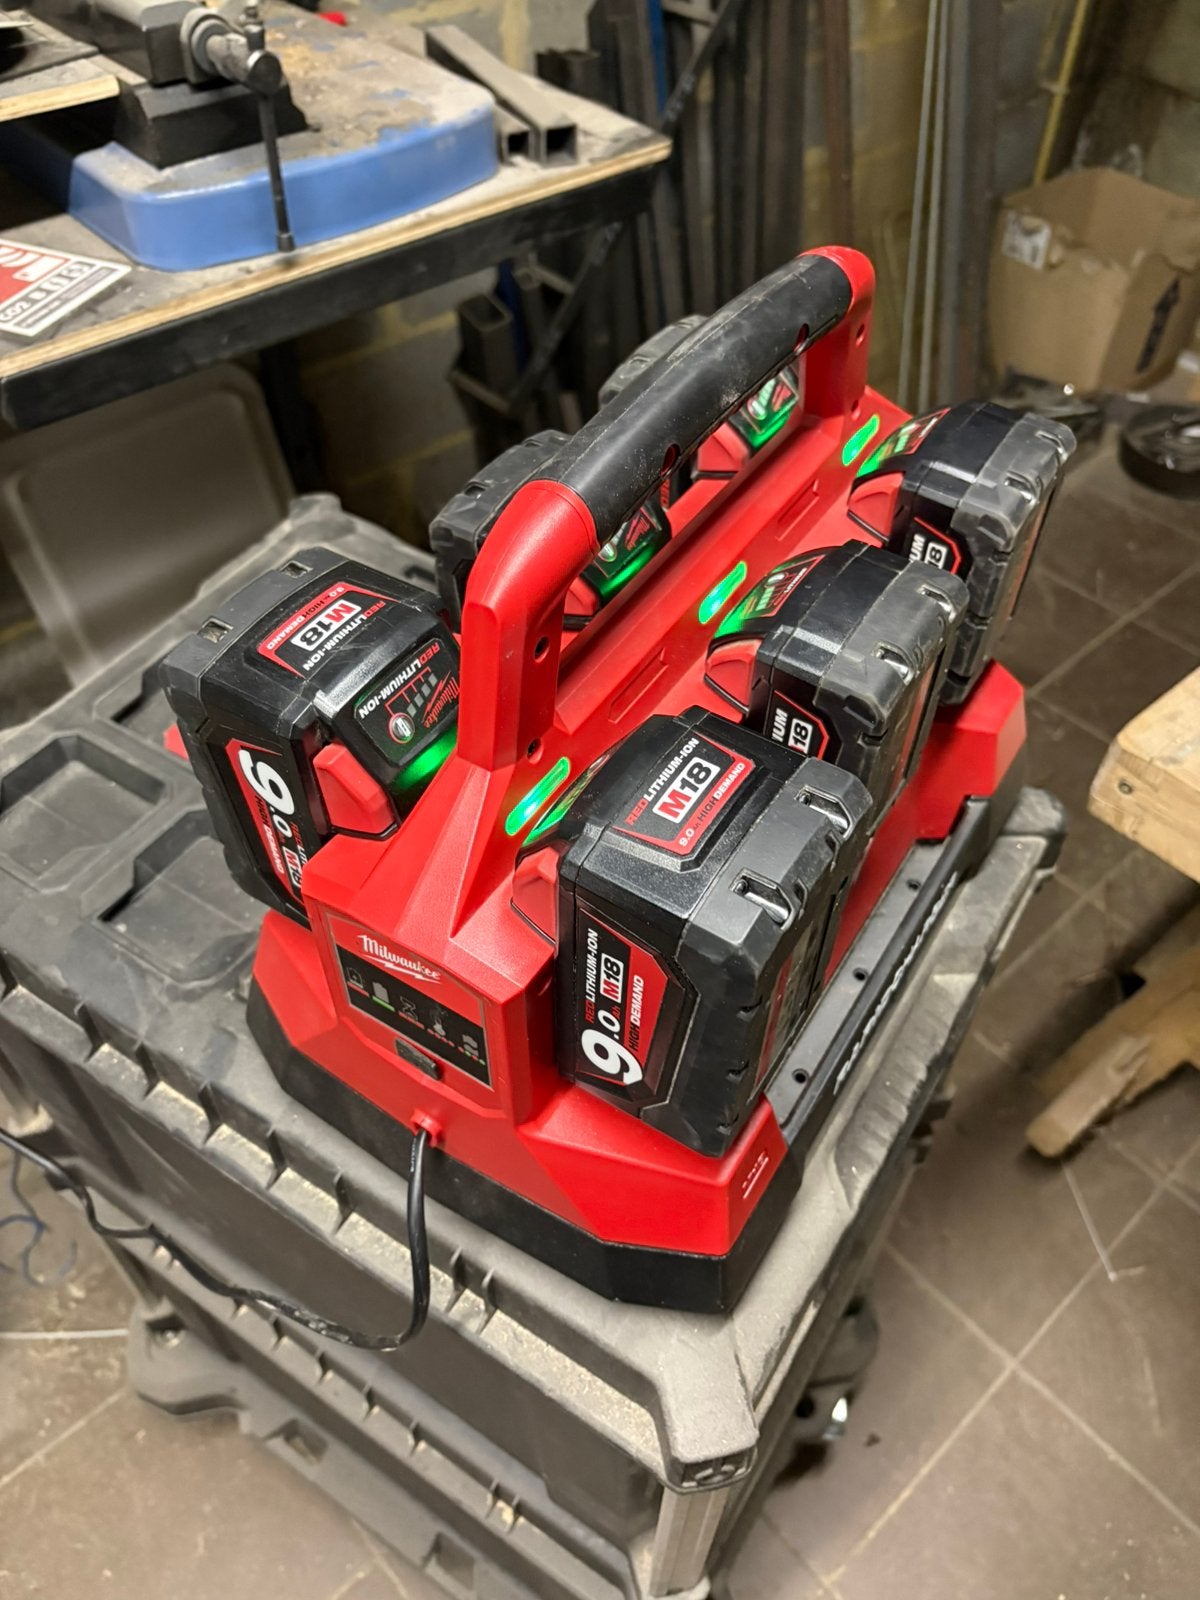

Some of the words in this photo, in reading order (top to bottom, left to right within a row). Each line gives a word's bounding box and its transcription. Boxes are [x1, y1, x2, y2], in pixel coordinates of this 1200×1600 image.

[300, 603, 356, 647] M18
[423, 676, 460, 729] Milwaukee
[791, 722, 809, 750] 18
[658, 762, 712, 819] M18
[357, 934, 441, 980] Milwaukee
[602, 958, 621, 1001] M18
